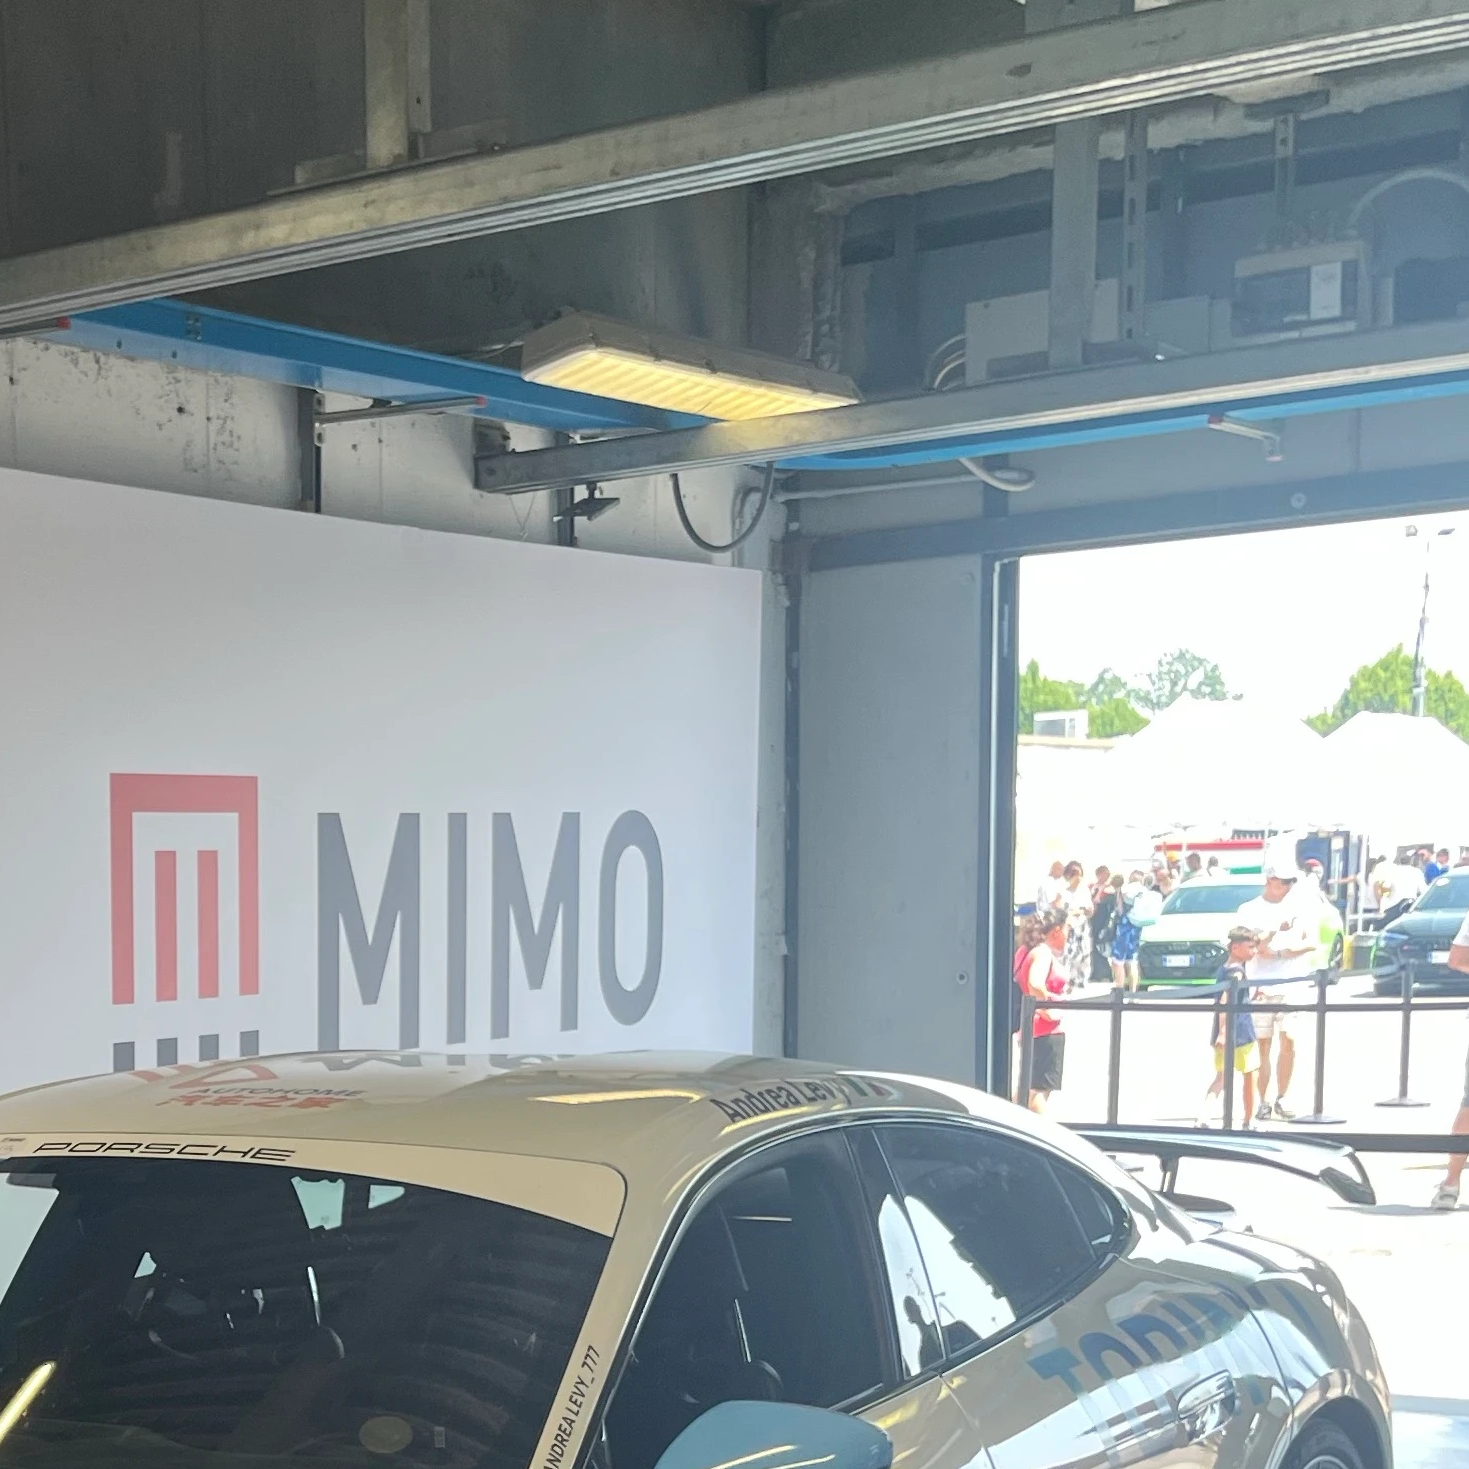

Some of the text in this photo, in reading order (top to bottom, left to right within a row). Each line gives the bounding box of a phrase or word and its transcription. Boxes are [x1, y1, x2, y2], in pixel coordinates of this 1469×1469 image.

[318, 809, 664, 1052] MIMO
[187, 1086, 368, 1098] AUTOHOME
[709, 1079, 801, 1123] Andrea
[32, 1142, 296, 1162] PORSCHE
